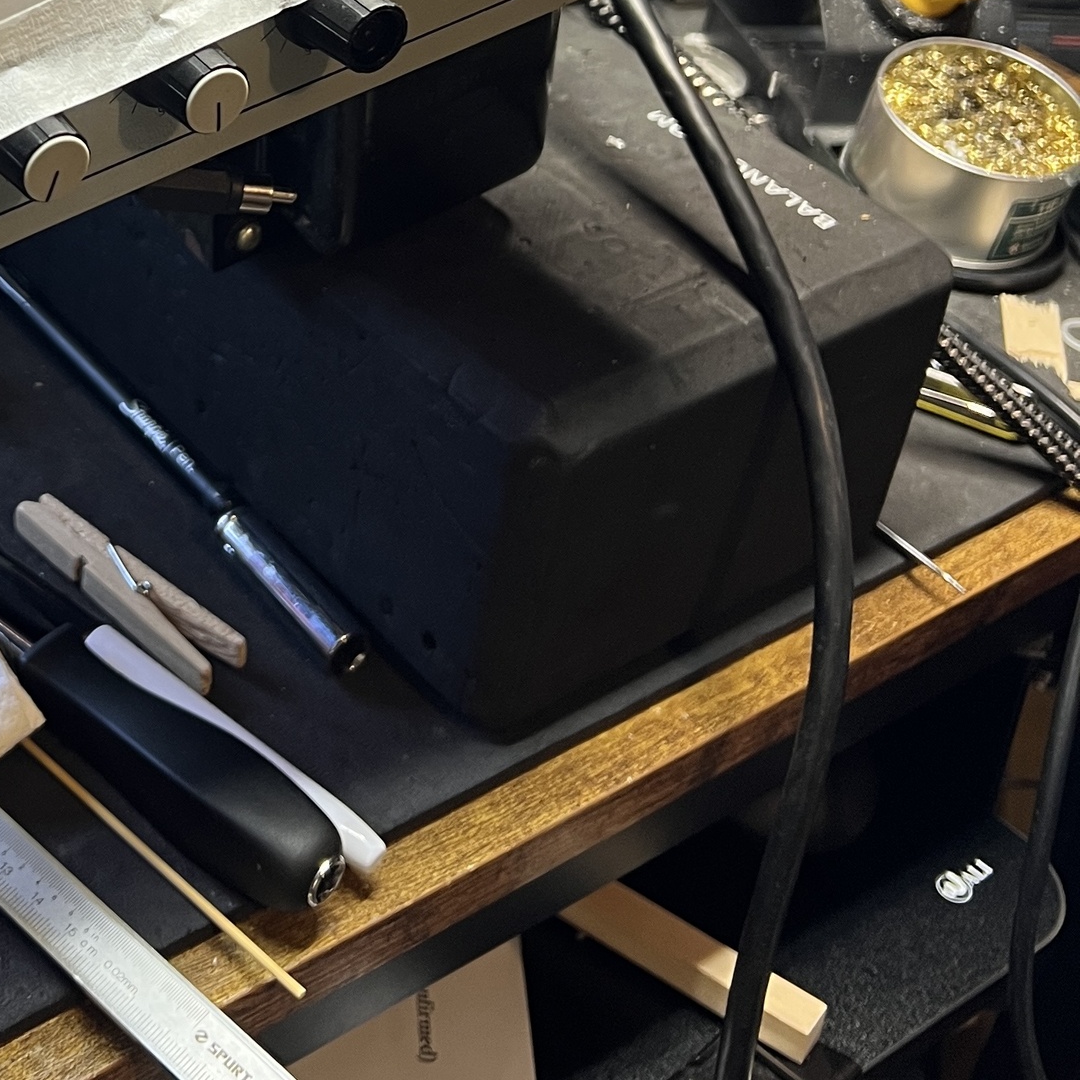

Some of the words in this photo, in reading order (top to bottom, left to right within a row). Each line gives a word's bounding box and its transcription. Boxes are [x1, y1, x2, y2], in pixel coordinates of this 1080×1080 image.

[0, 861, 14, 877] 13
[30, 891, 45, 906] 14
[64, 923, 78, 938] 15
[103, 959, 140, 997] 0.02mm
